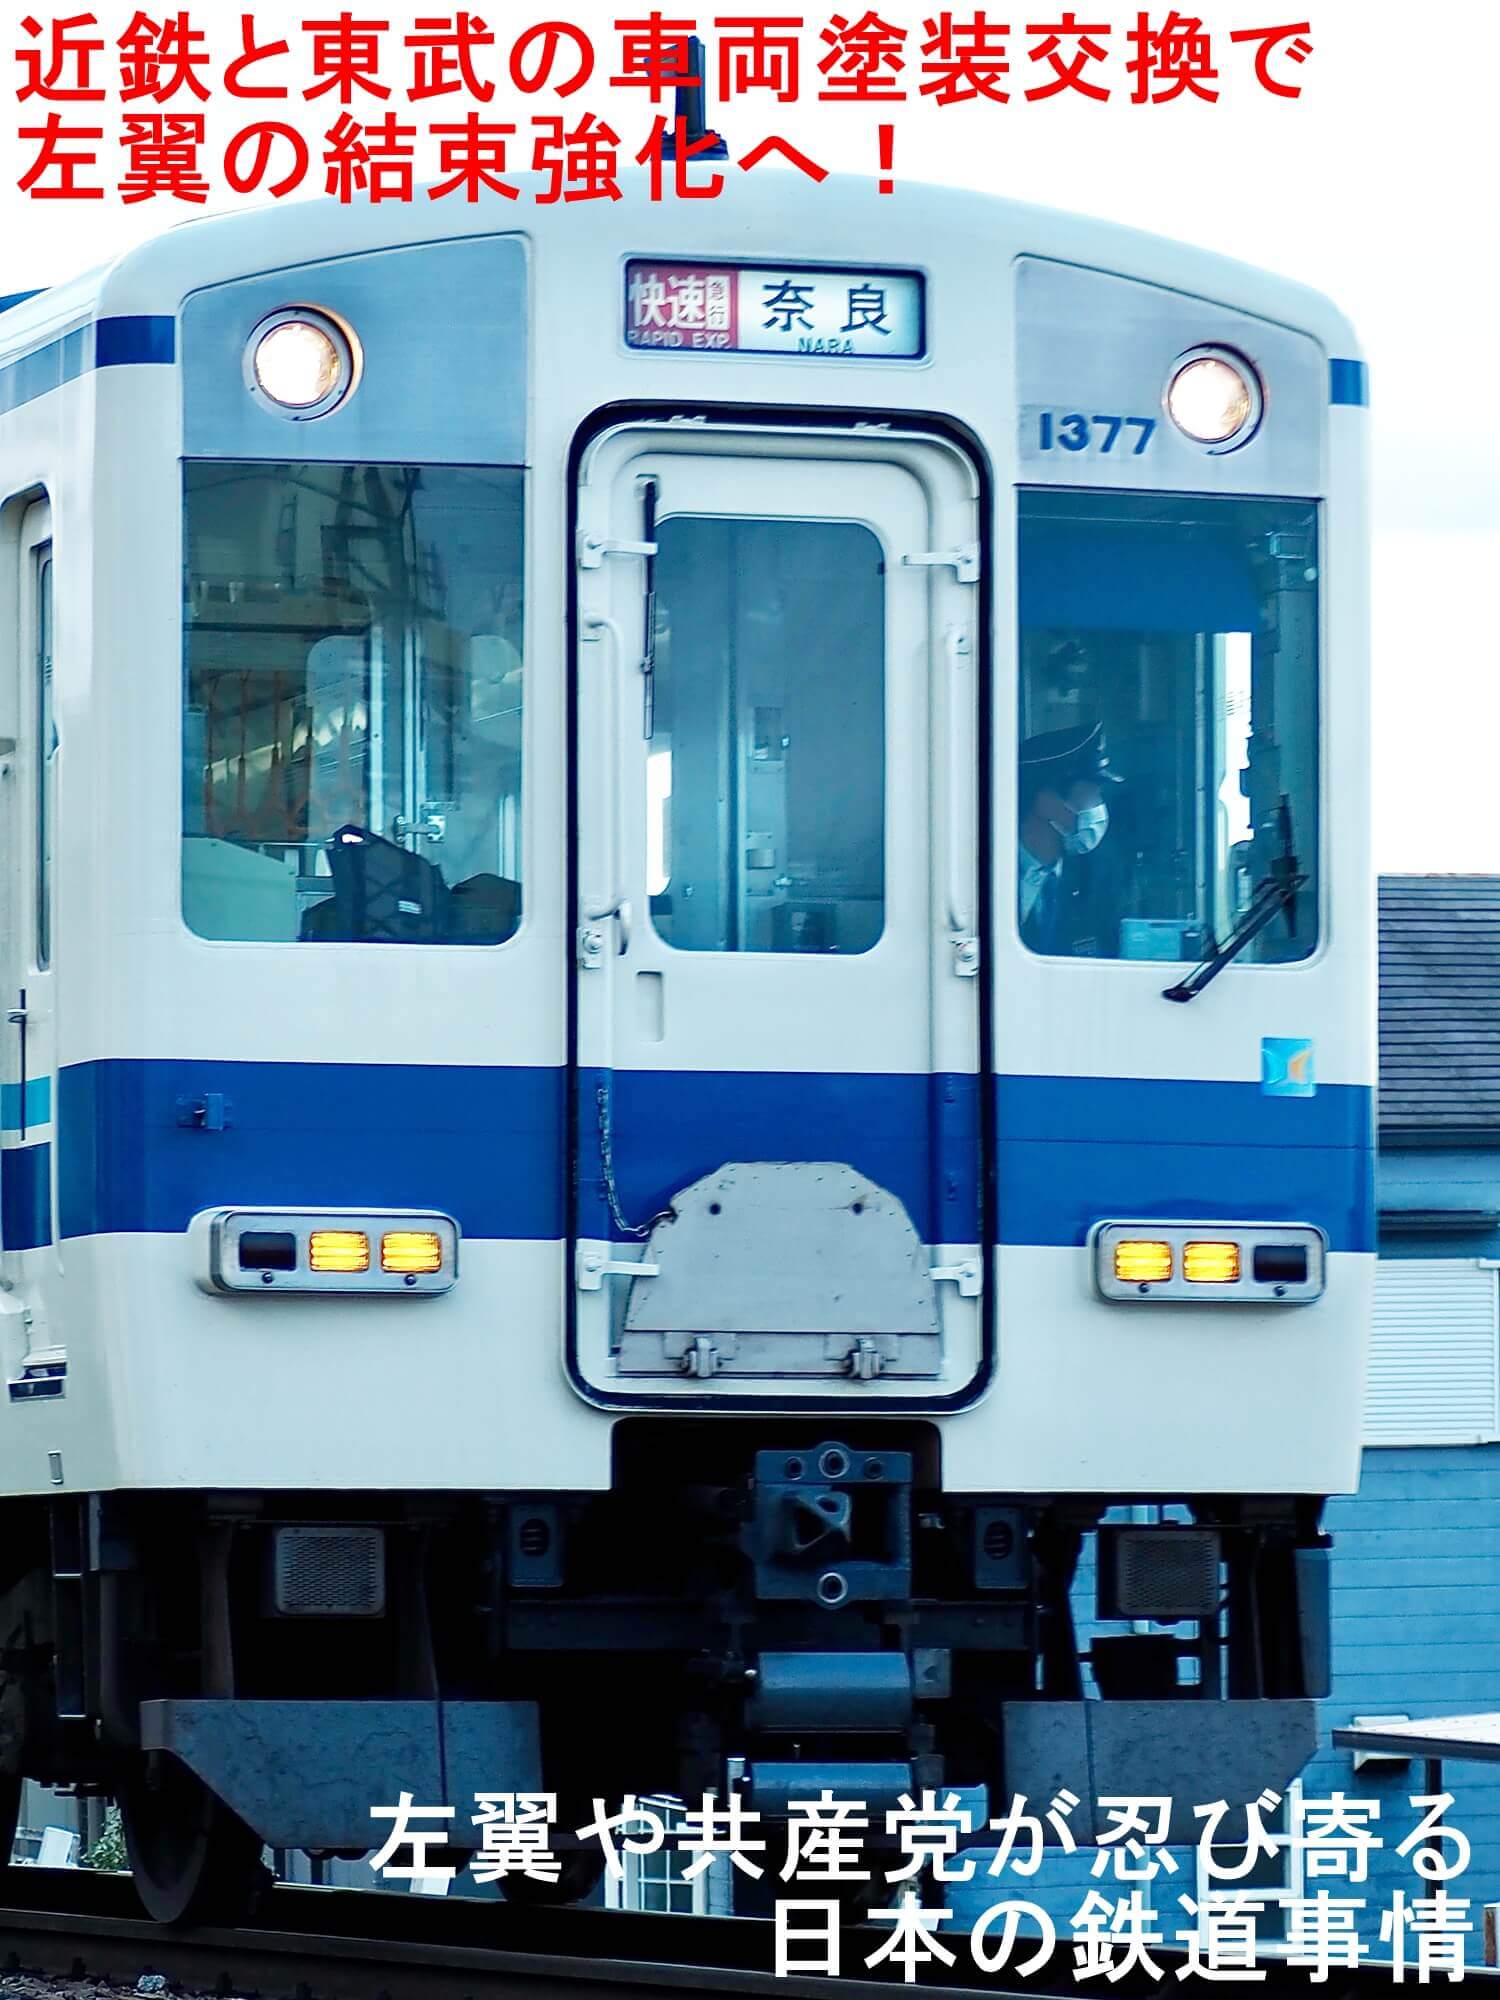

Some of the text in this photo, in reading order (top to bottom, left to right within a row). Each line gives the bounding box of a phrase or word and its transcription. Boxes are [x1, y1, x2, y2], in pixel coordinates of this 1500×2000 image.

[761, 280, 892, 335] 奈良
[798, 337, 854, 354] NARA
[1040, 412, 1156, 455] 1377
